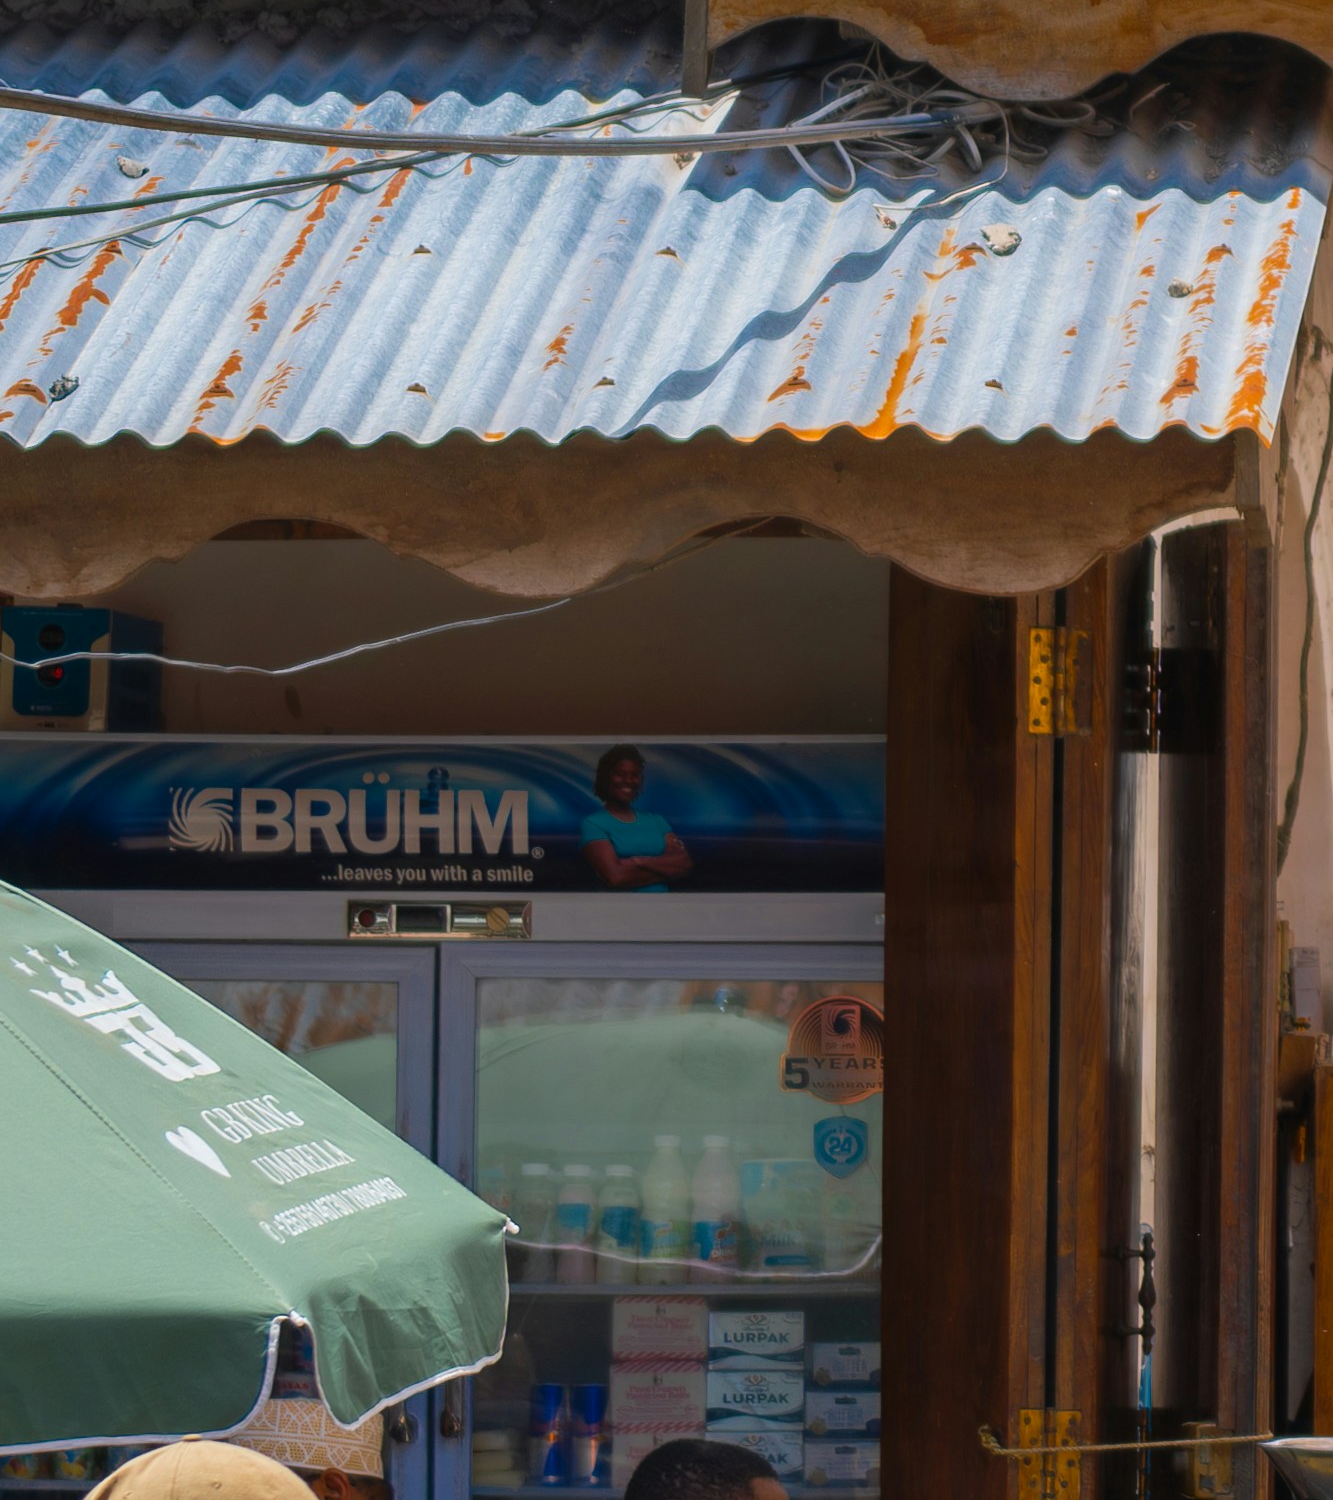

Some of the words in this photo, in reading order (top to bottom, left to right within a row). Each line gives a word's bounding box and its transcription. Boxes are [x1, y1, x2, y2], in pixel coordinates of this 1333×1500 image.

[241, 772, 529, 855] BRÜHM
[396, 867, 428, 885] you
[430, 865, 468, 883] with
[472, 870, 483, 882] a
[487, 865, 534, 884] smile
[784, 1057, 810, 1090] 5
[250, 1138, 356, 1186] UMBRELLA
[723, 1332, 790, 1344] LURPAK
[722, 1392, 789, 1405] LURPAK
